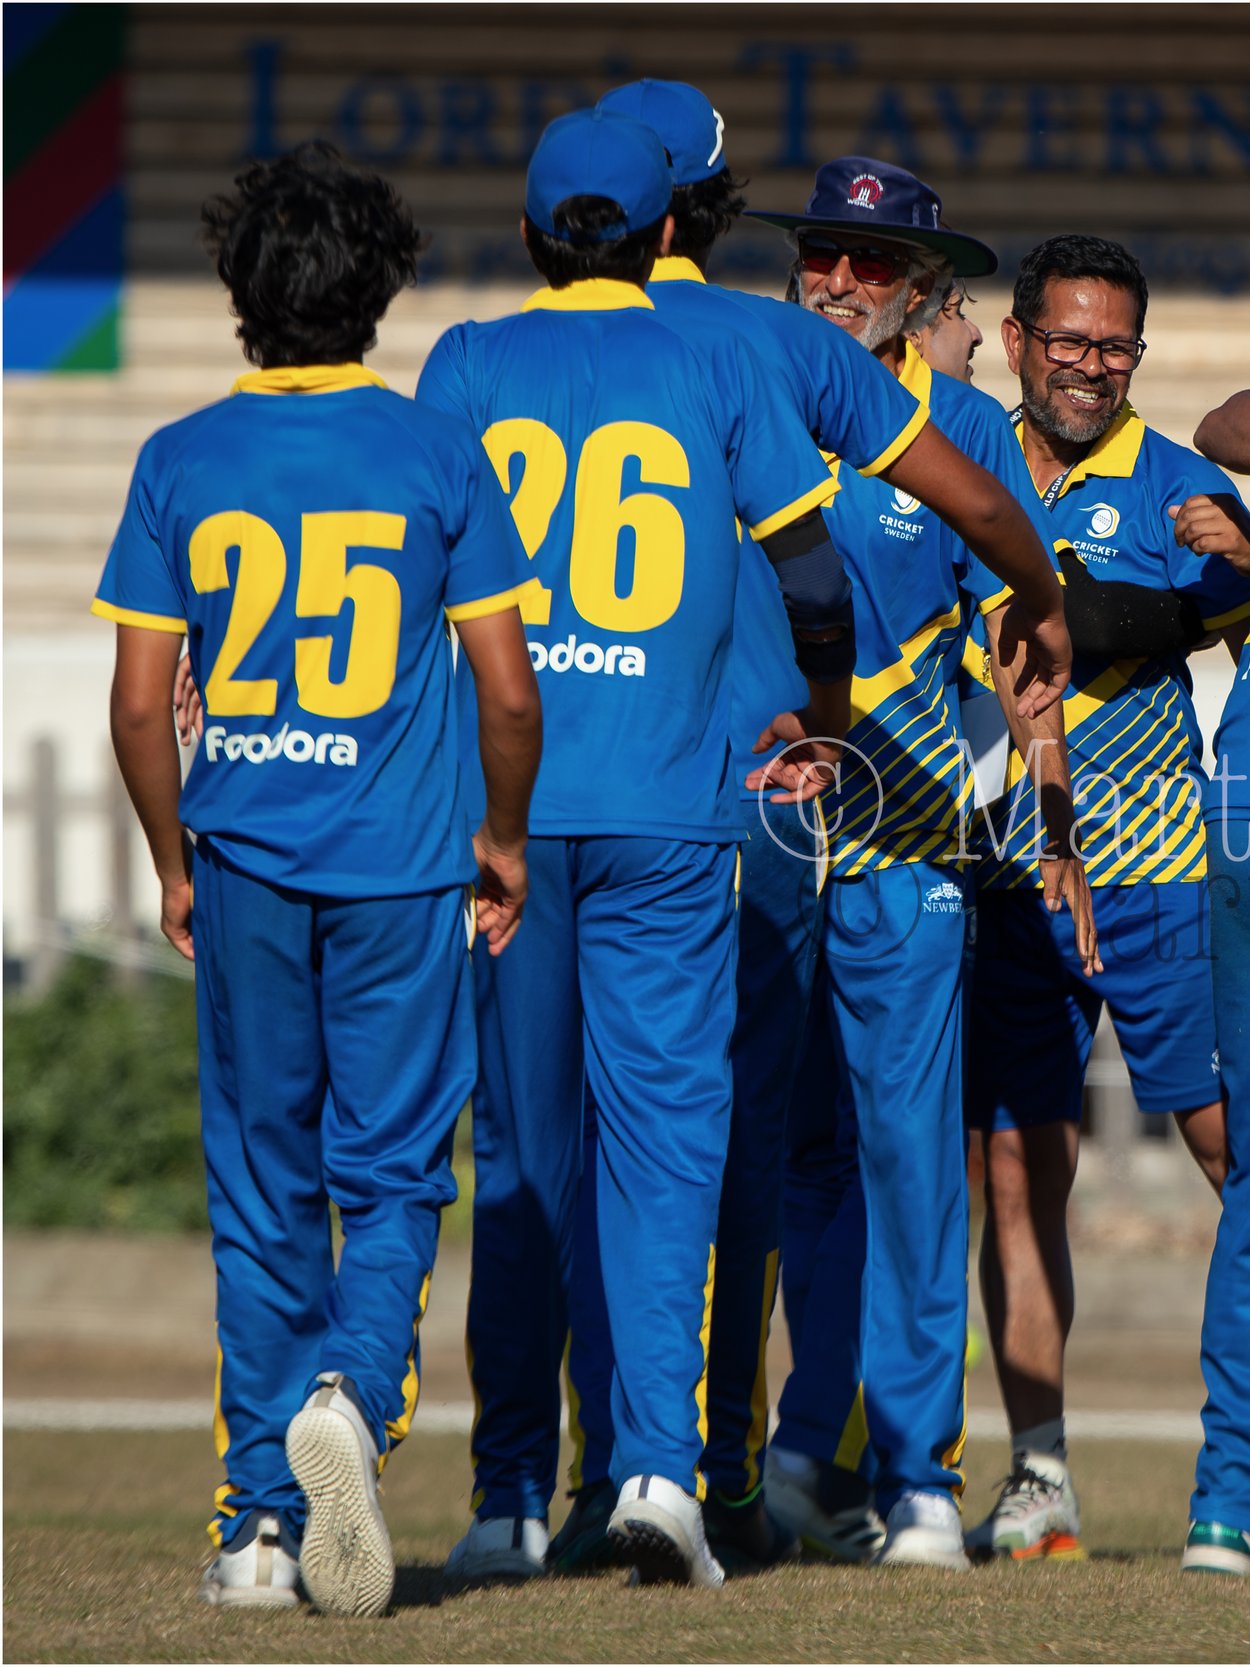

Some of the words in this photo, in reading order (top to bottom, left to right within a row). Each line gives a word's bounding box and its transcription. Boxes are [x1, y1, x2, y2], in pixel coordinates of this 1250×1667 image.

[481, 417, 692, 633] 26
[879, 514, 924, 535] CRICKET
[884, 527, 916, 542] SWEDEN
[1072, 540, 1119, 557] CRICKET
[188, 510, 408, 720] 25
[526, 634, 647, 678] odora
